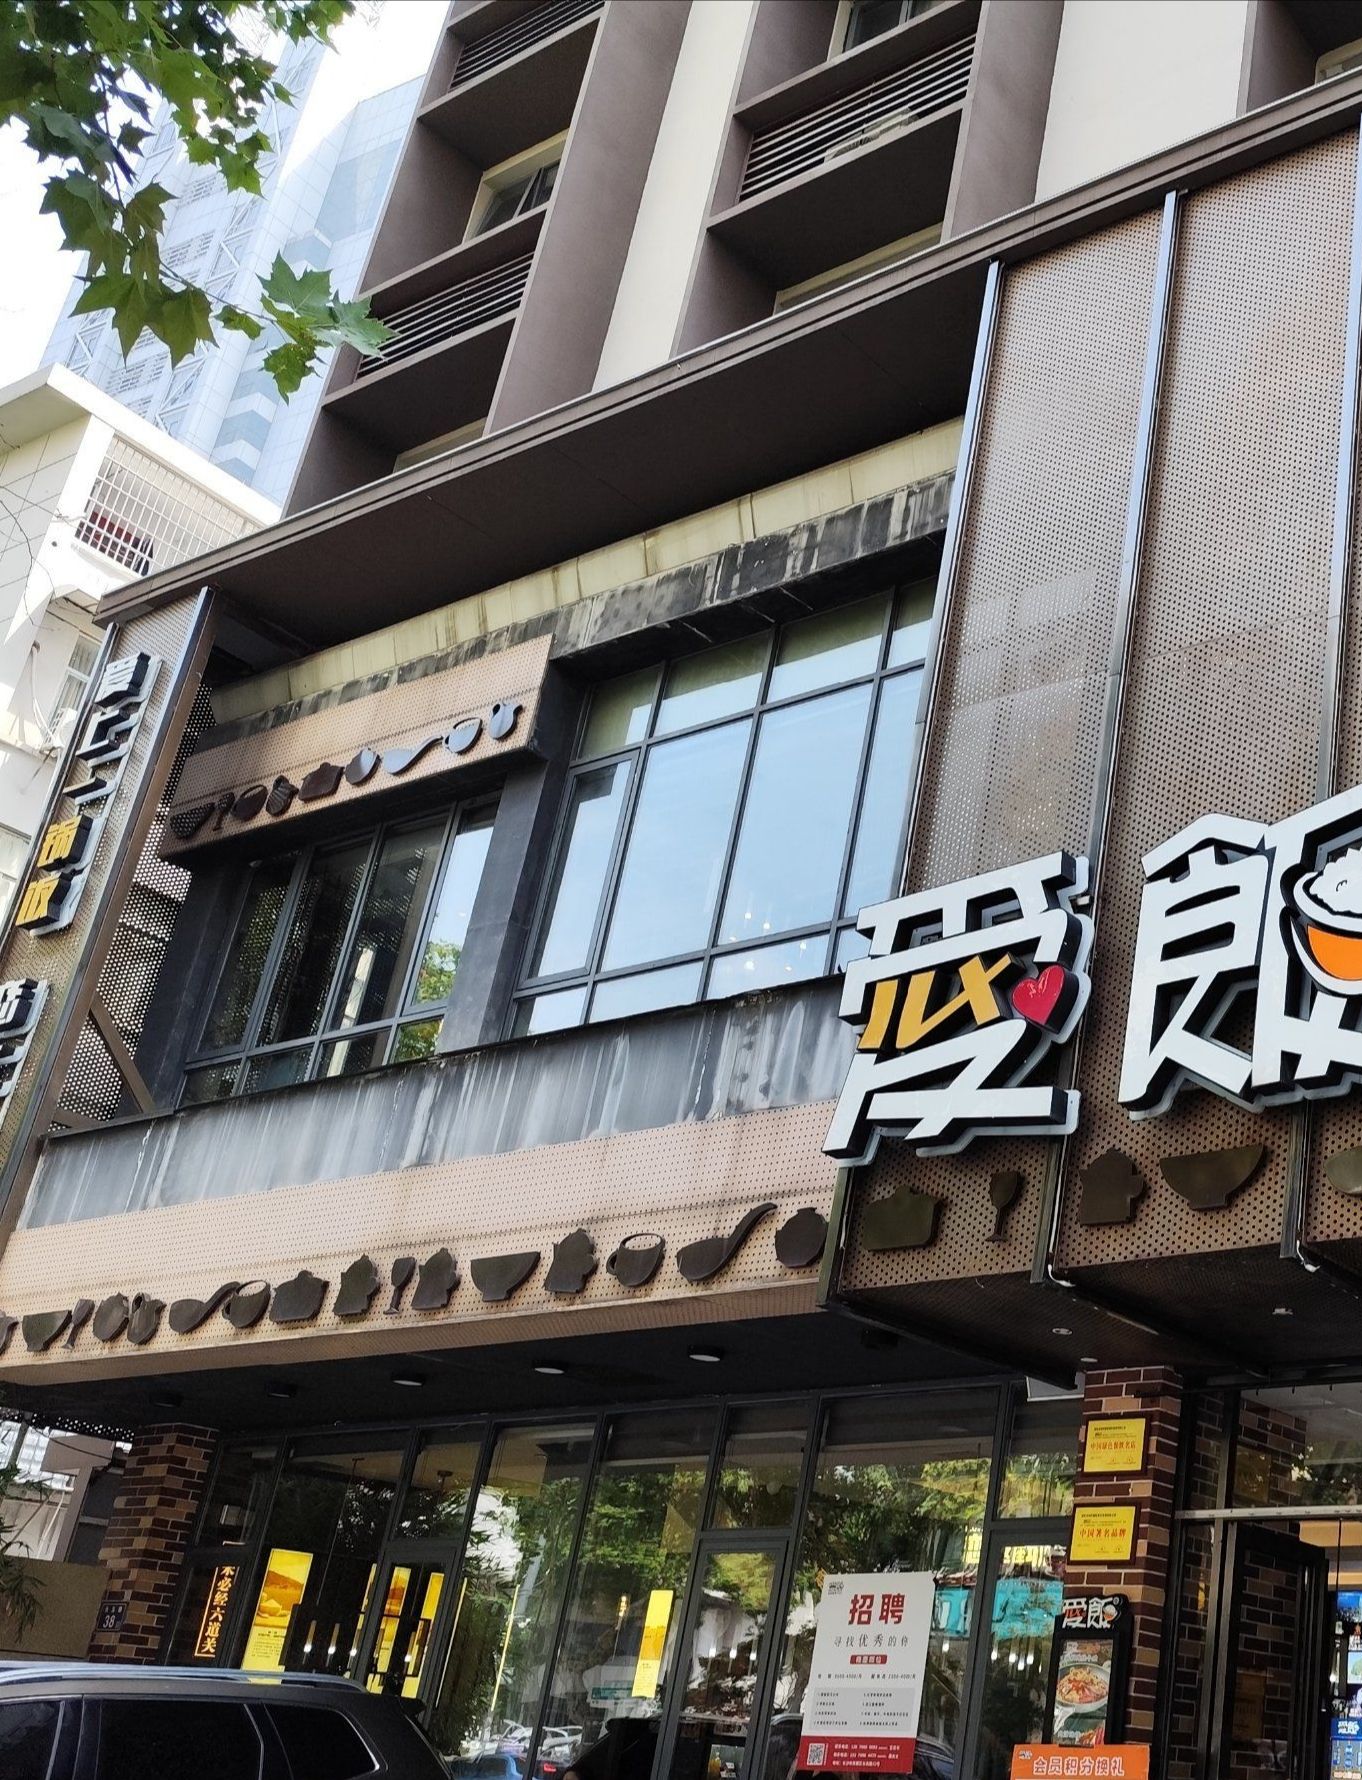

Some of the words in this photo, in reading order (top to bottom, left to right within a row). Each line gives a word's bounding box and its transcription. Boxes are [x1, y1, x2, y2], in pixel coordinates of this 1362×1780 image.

[848, 1593, 906, 1626] 招聘
[833, 1633, 909, 1648] 寻找优秀的你
[1033, 1756, 1125, 1777] 会员积分换礼
